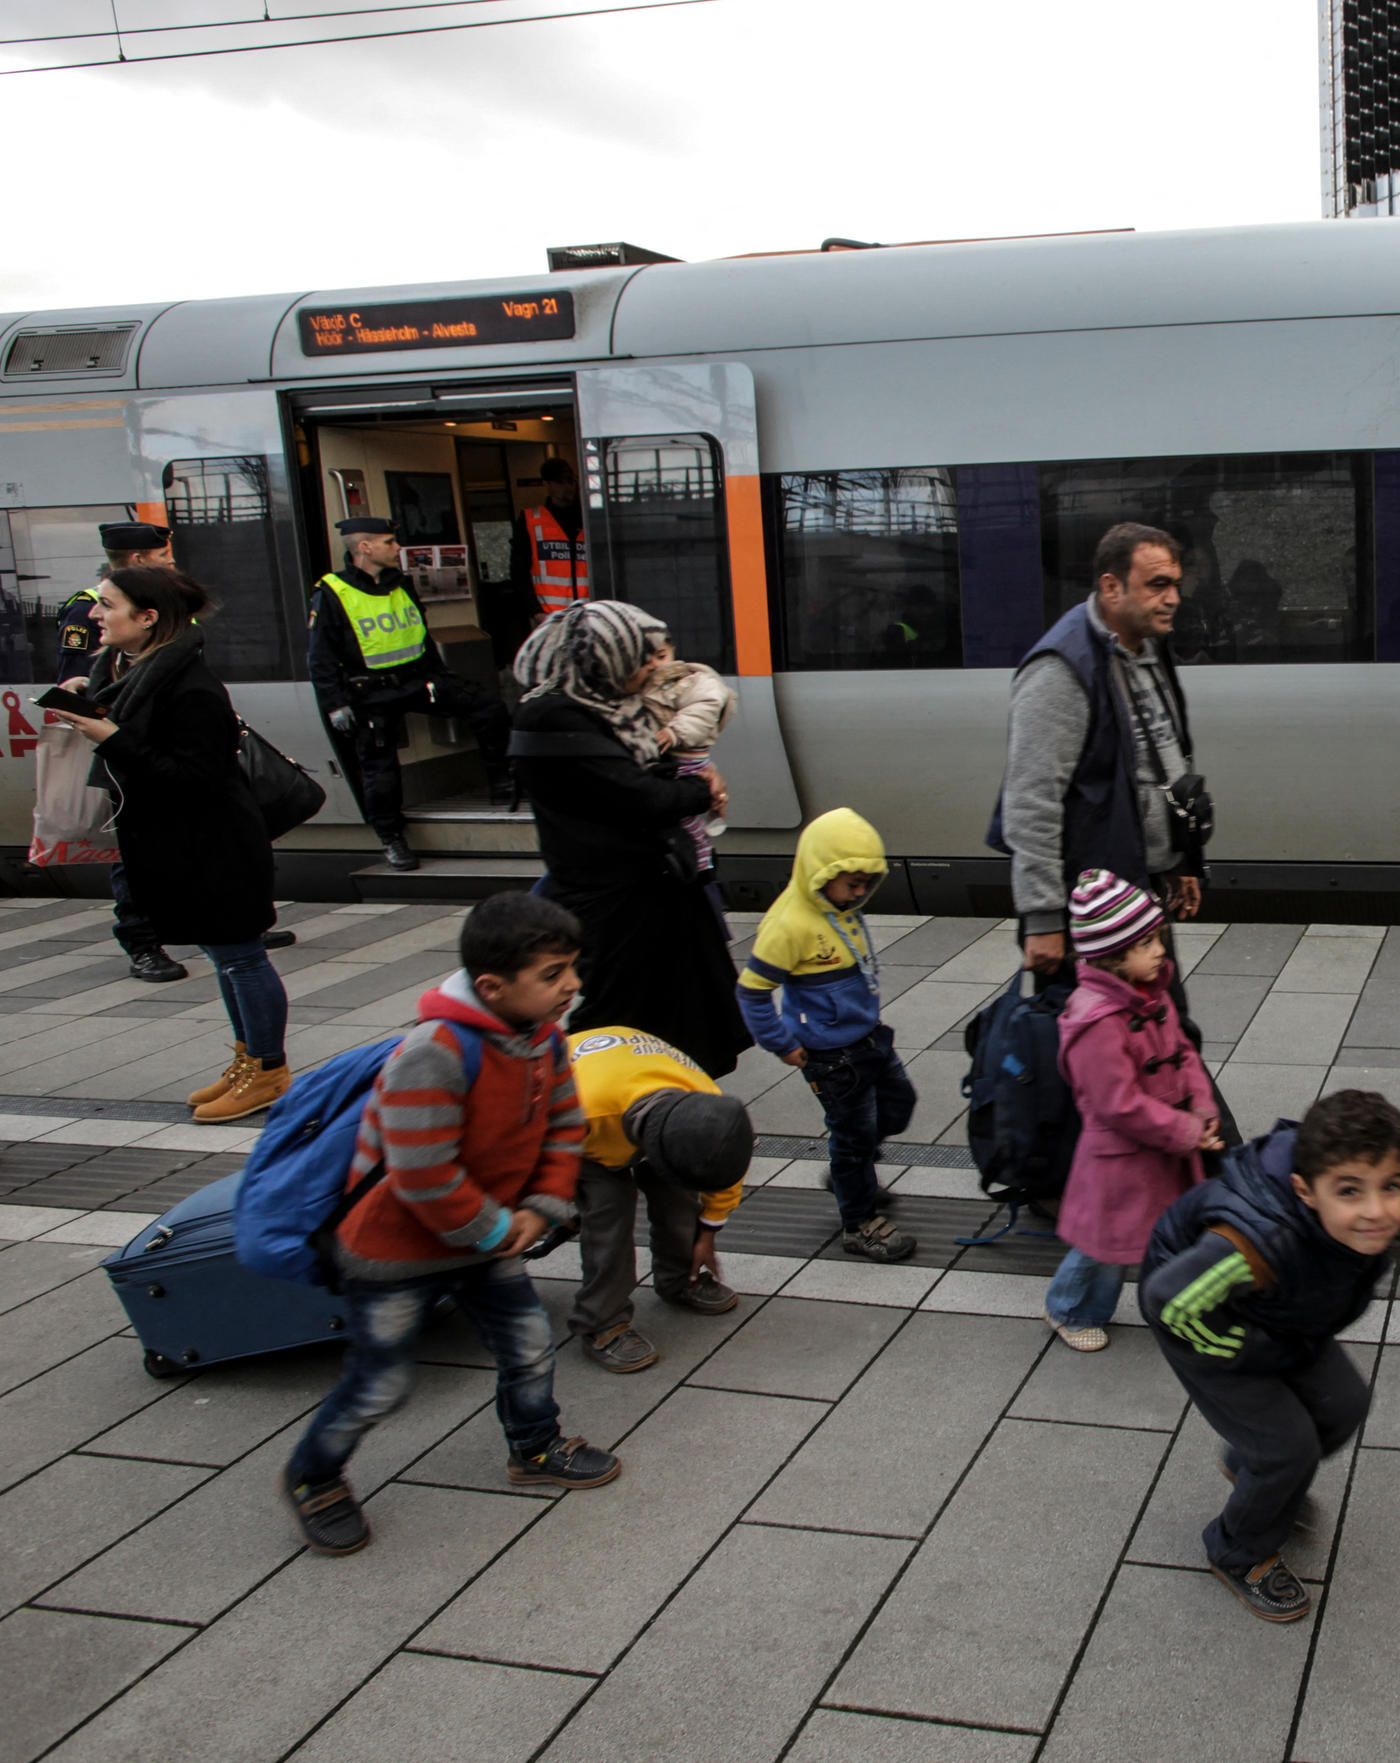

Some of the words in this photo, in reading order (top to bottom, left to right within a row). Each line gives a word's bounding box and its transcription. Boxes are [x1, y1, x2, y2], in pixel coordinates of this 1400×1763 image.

[502, 301, 539, 319] Vagn
[542, 298, 558, 314] 21
[350, 312, 362, 328] C
[358, 605, 421, 638] POLIS
